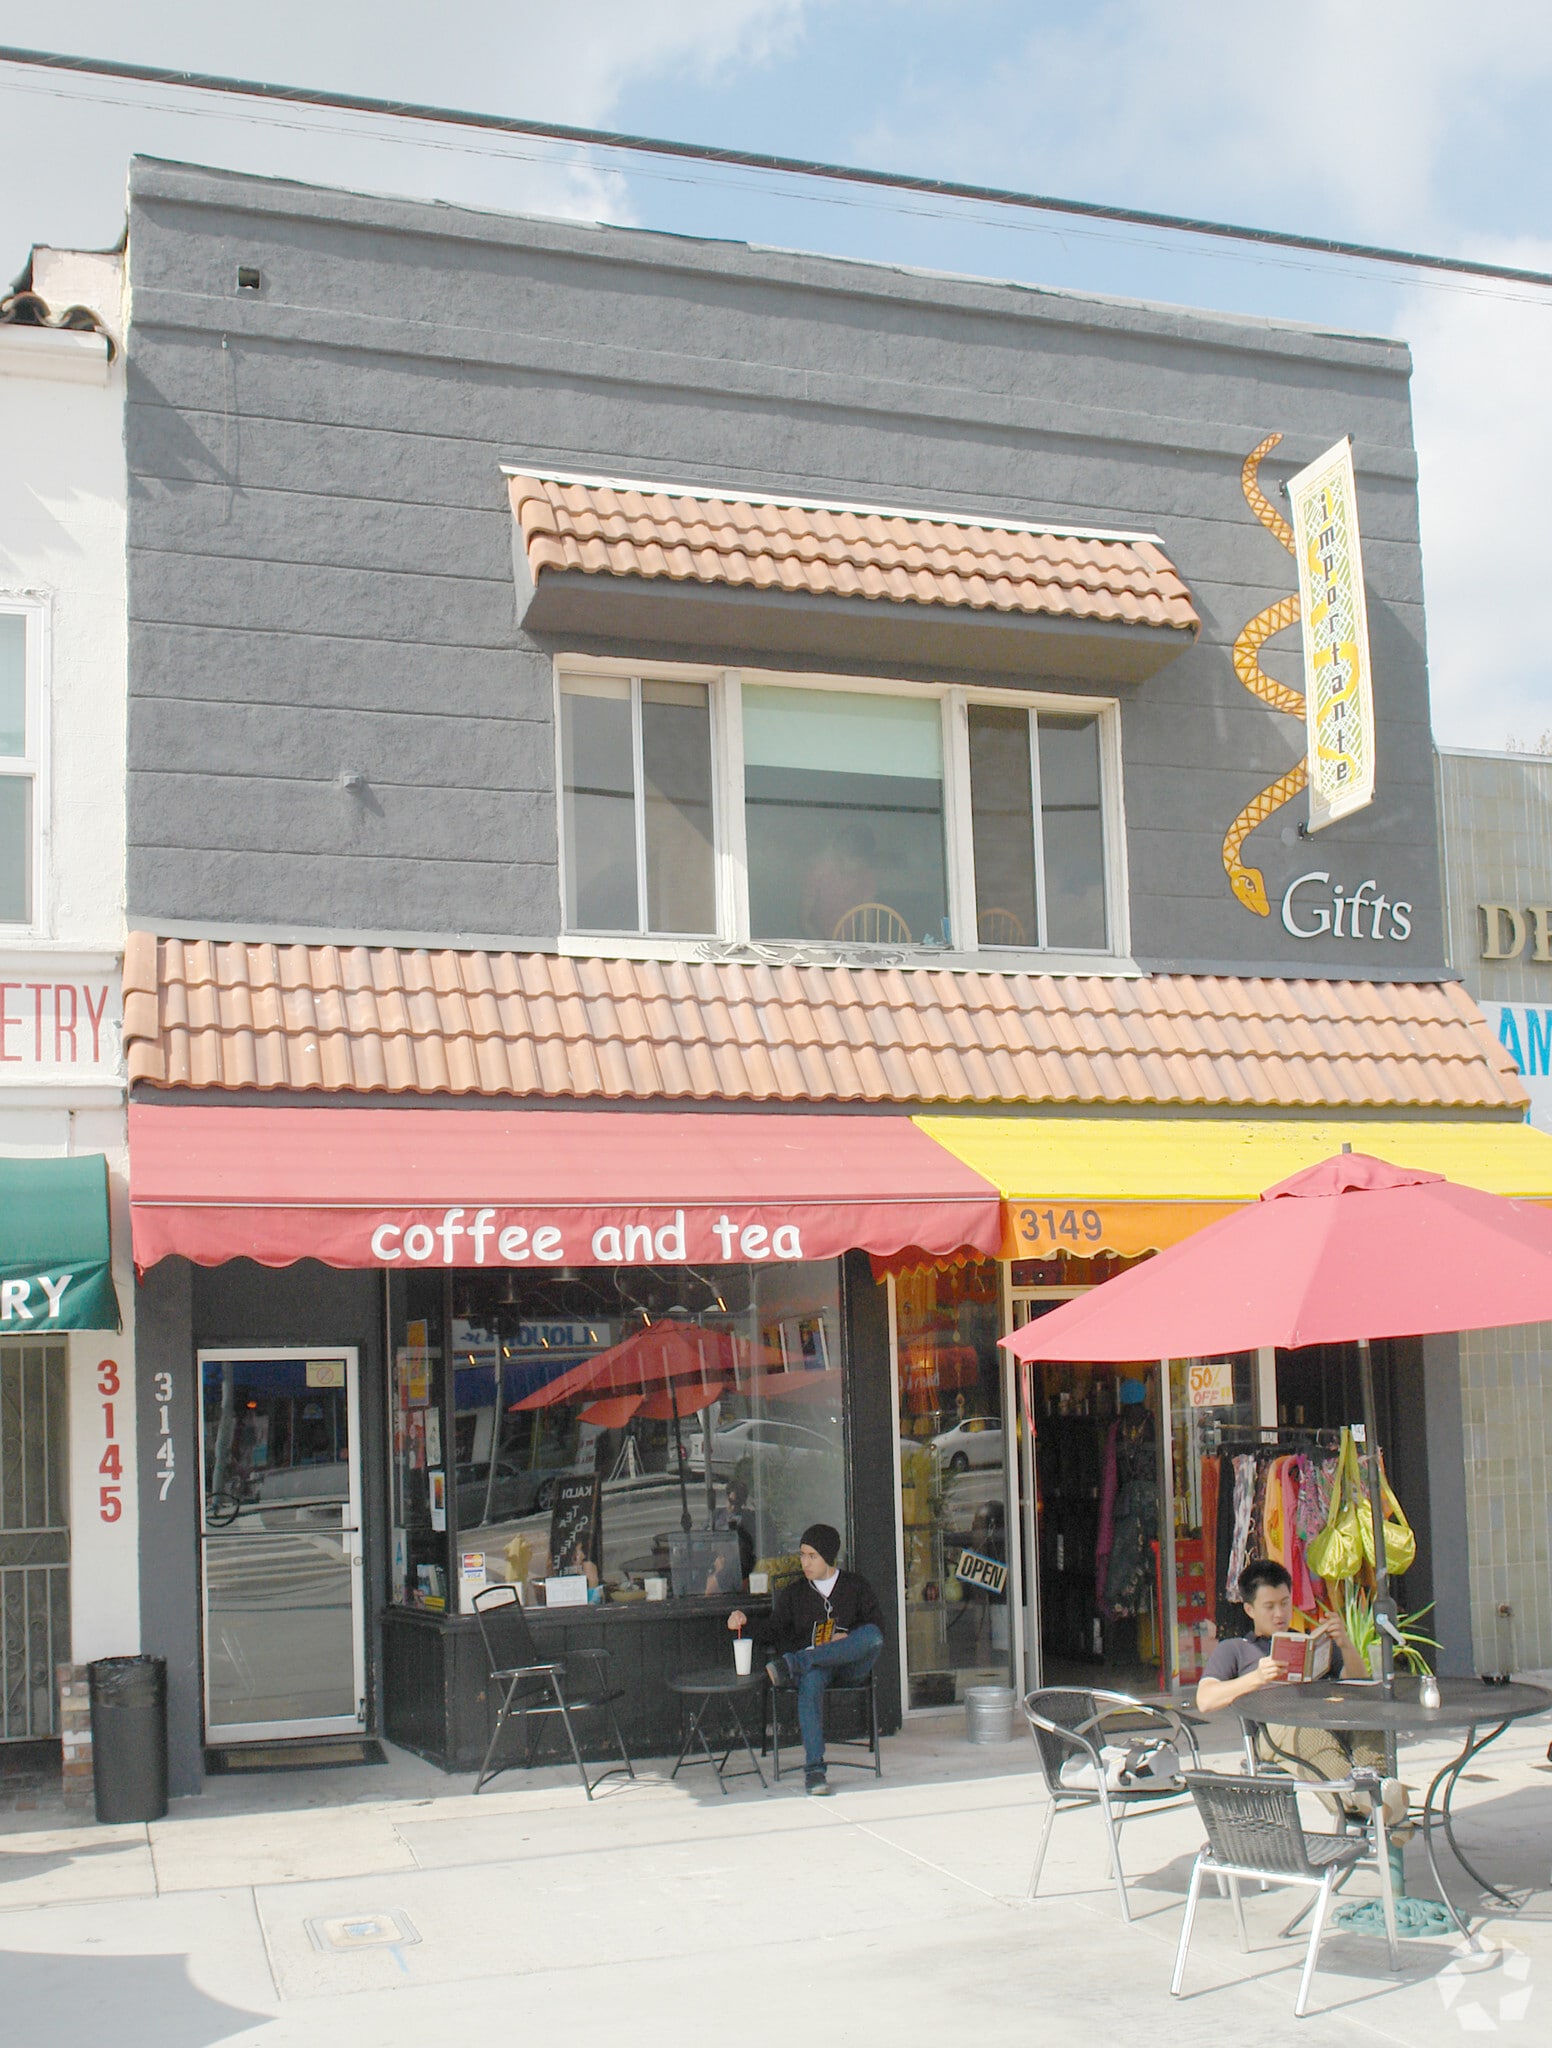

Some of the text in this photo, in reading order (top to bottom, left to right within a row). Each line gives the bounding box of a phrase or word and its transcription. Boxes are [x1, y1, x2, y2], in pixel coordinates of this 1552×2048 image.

[1319, 493, 1348, 786] importante
[1282, 871, 1412, 941] Gifts
[0, 983, 108, 1062] ETRY
[371, 1208, 803, 1264] coffee and tea
[1020, 1208, 1102, 1241] 3149
[1, 1275, 73, 1320] RY
[1190, 1366, 1222, 1392] 50%
[97, 1359, 123, 1523] 3145
[154, 1372, 175, 1501] 3147
[960, 1554, 1004, 1589] OPEN
